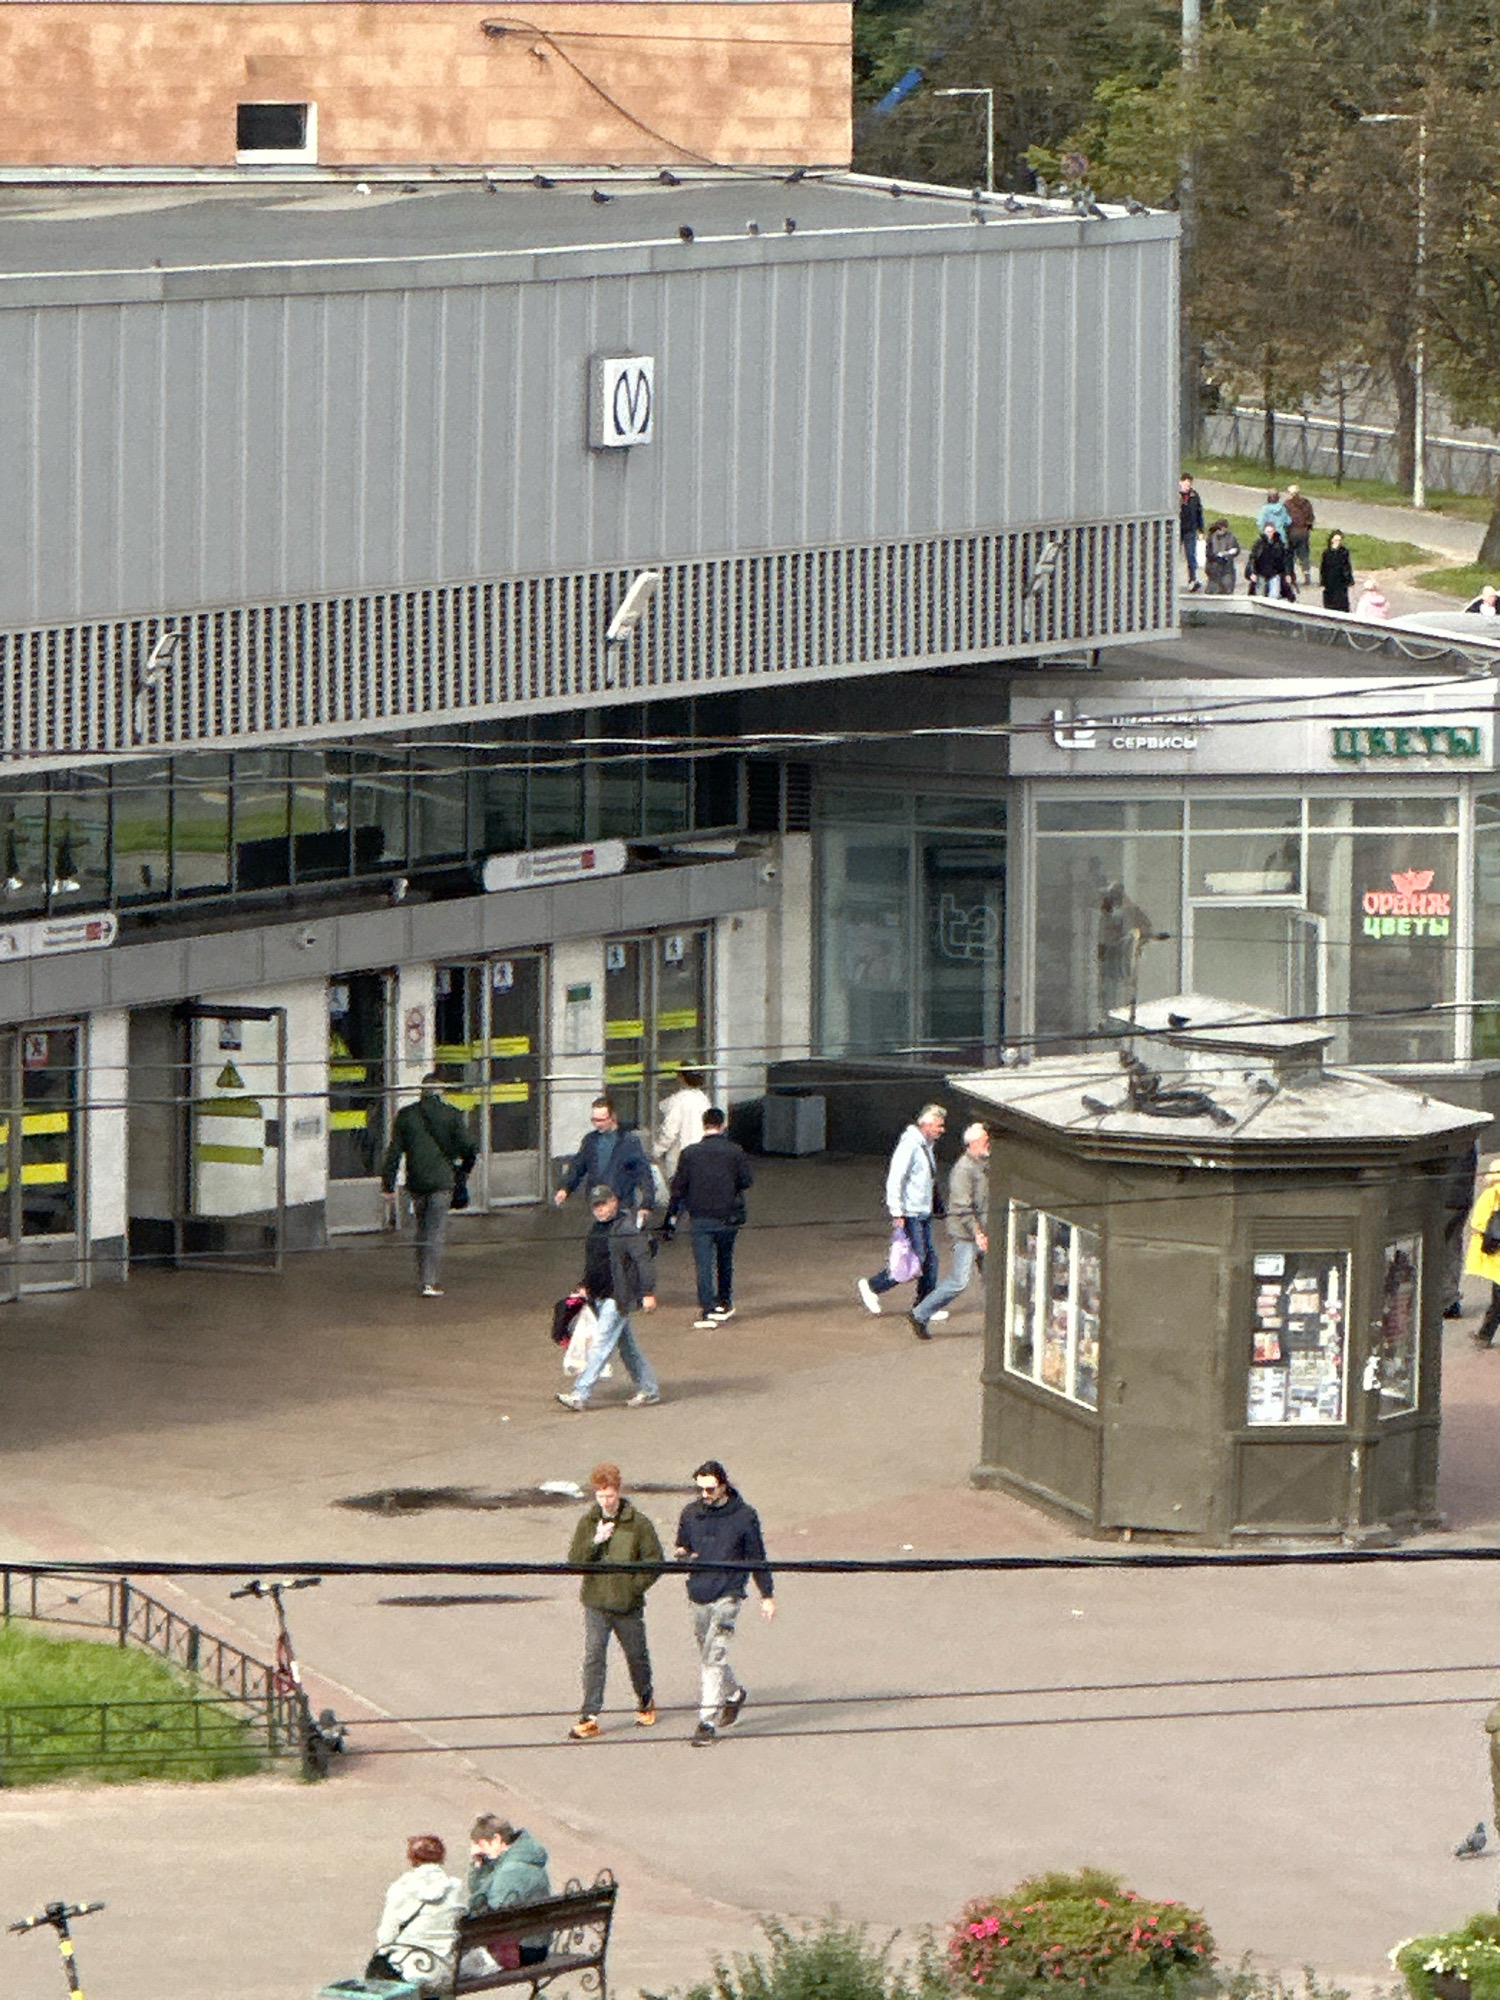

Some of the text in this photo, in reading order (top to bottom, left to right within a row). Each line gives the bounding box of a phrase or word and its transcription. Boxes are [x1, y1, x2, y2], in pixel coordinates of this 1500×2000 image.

[1112, 736, 1198, 749] СЕРВИСЫ
[1332, 727, 1480, 763] ЦВЕТЫ
[1363, 917, 1449, 939] ЦВЕТЫ
